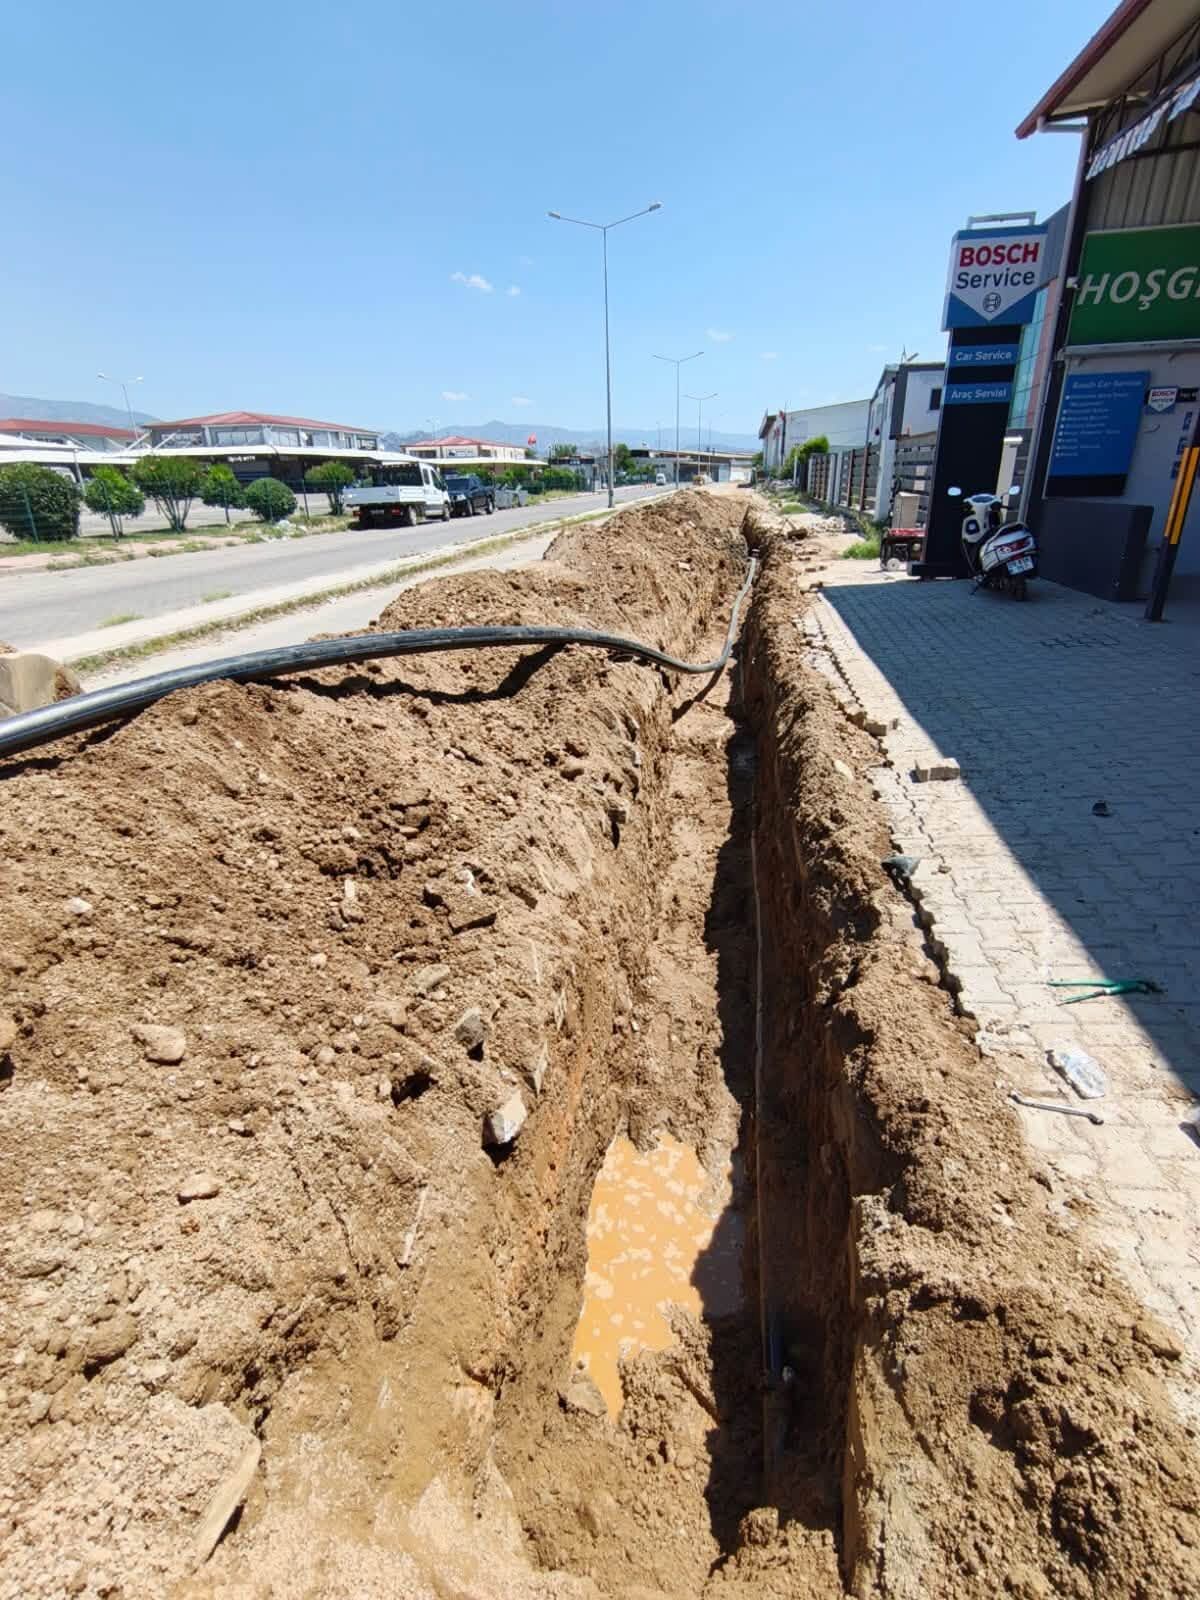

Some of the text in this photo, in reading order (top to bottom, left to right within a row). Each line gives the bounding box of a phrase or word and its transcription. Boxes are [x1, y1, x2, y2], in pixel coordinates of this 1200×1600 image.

[959, 242, 1040, 268] BOSCH
[955, 267, 1035, 289] Service
[1077, 267, 1200, 310] HOŞG
[955, 350, 1012, 361] Car Service
[951, 389, 973, 400] Araç
